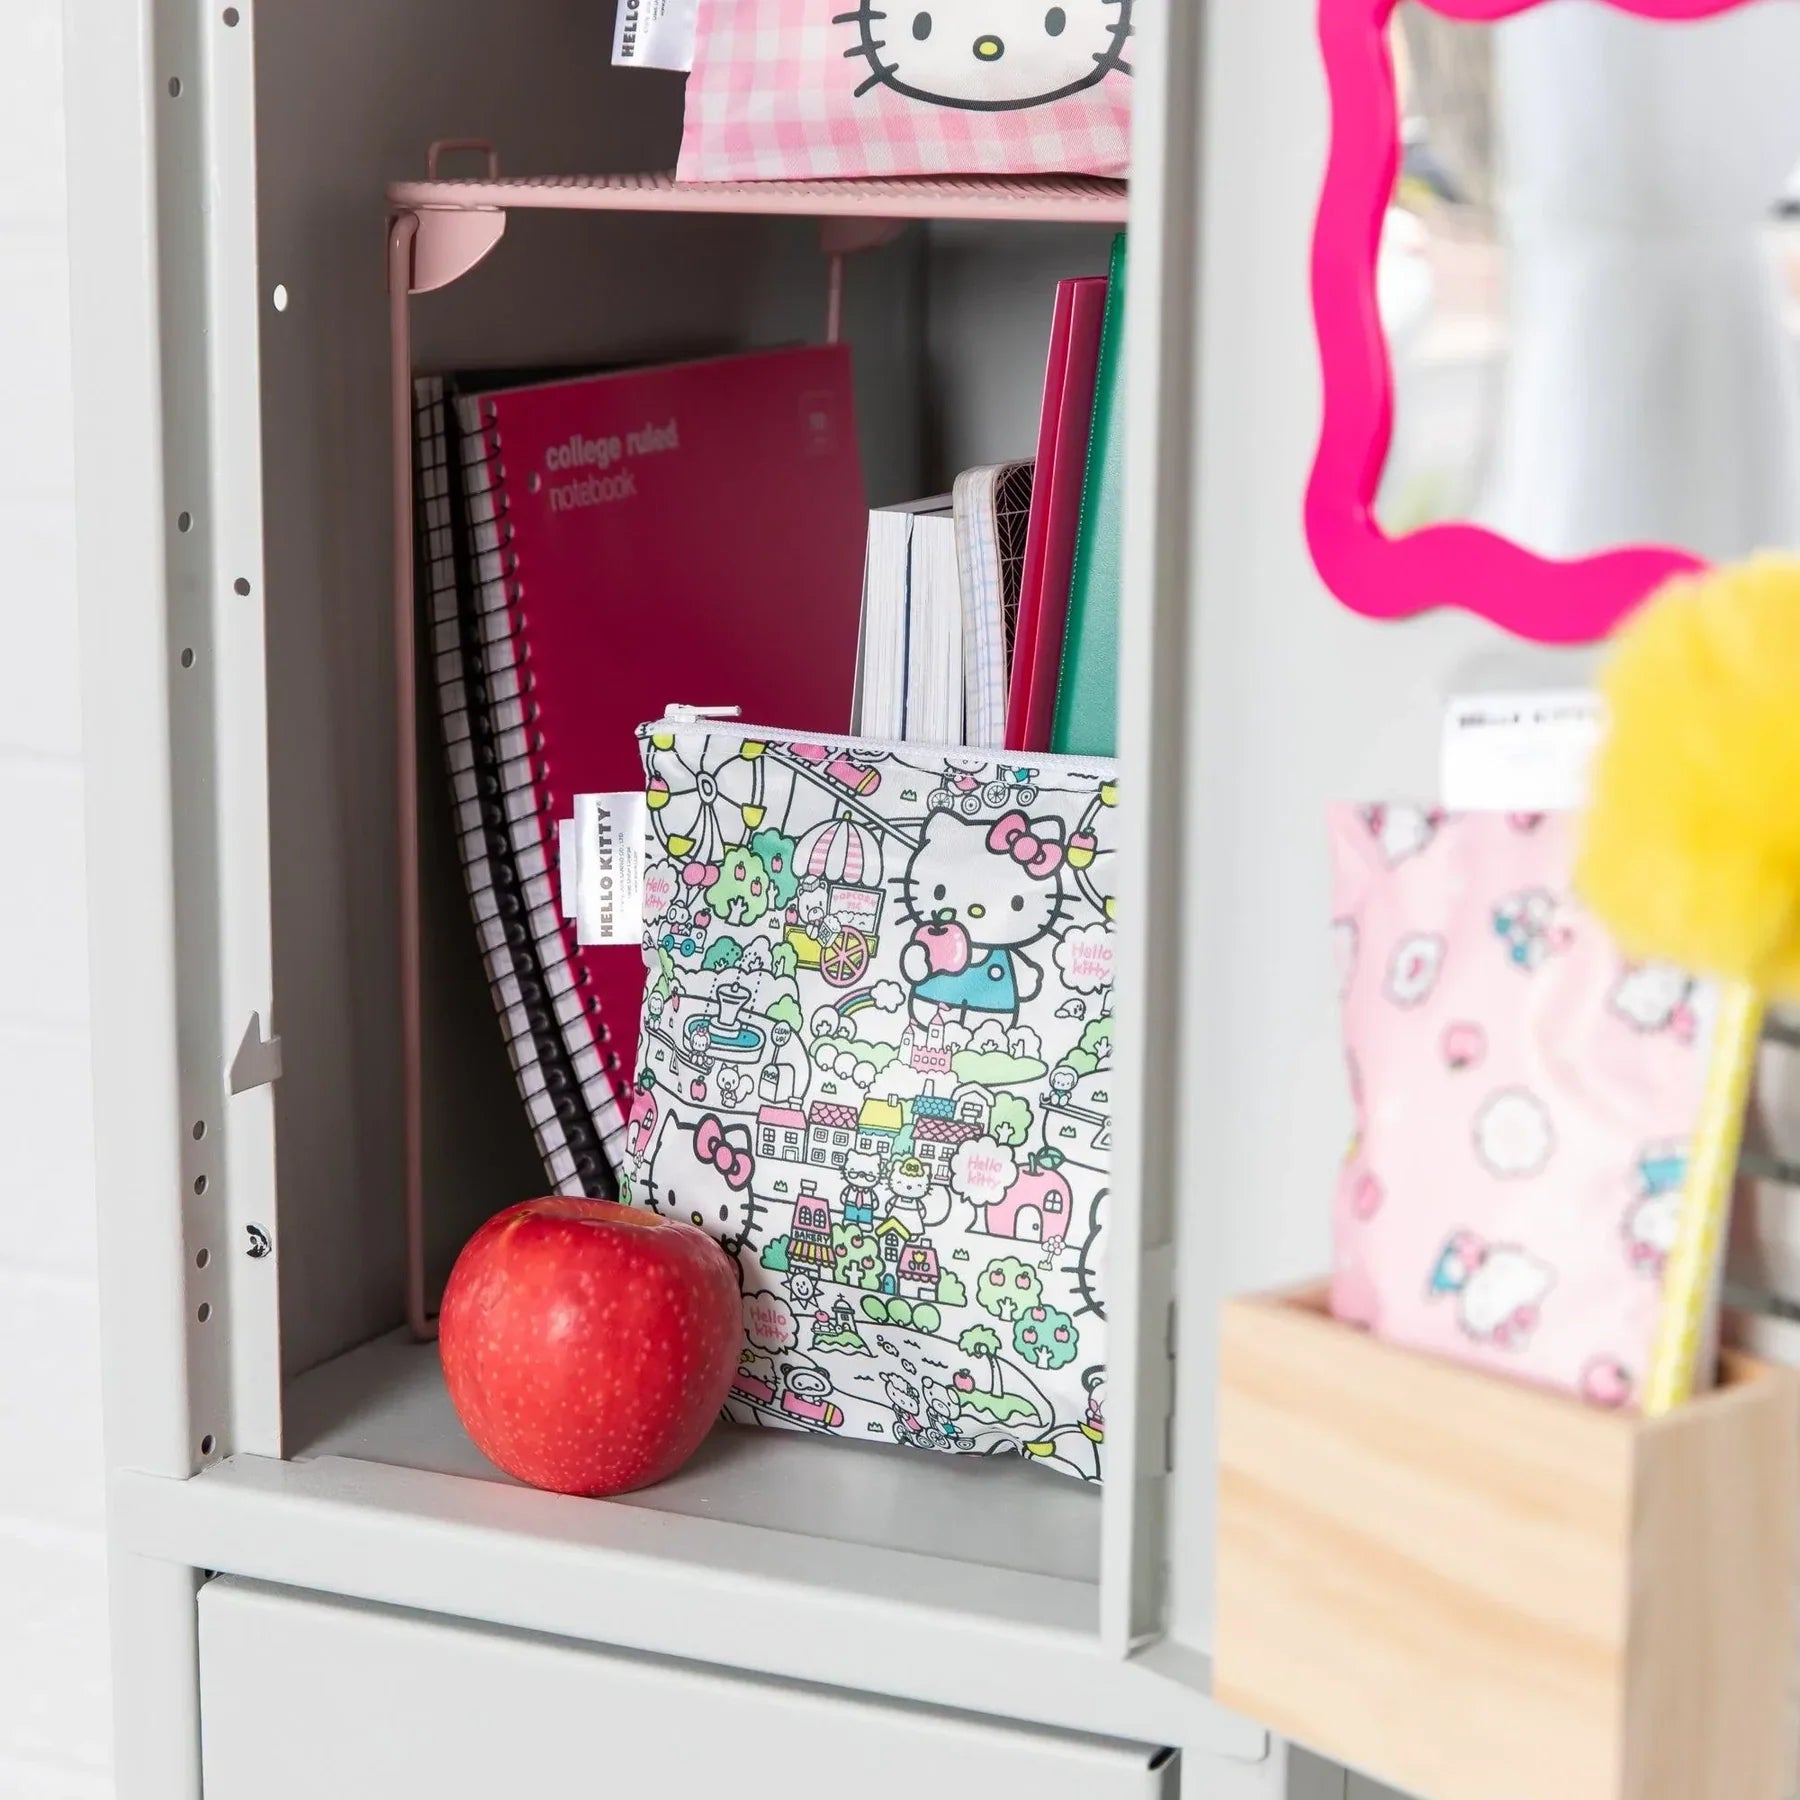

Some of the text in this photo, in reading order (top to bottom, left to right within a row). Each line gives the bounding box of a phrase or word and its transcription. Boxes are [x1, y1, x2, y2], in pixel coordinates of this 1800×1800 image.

[621, 0, 640, 57] HELLO
[546, 417, 679, 470] college ruled
[550, 467, 637, 512] notebook
[598, 807, 613, 937] HELLO KITTY
[646, 877, 670, 893] Hello
[1072, 942, 1113, 960] Hello
[968, 1155, 1003, 1172] Hello
[795, 1230, 830, 1244] BAKERY
[750, 1306, 786, 1325] Hello
